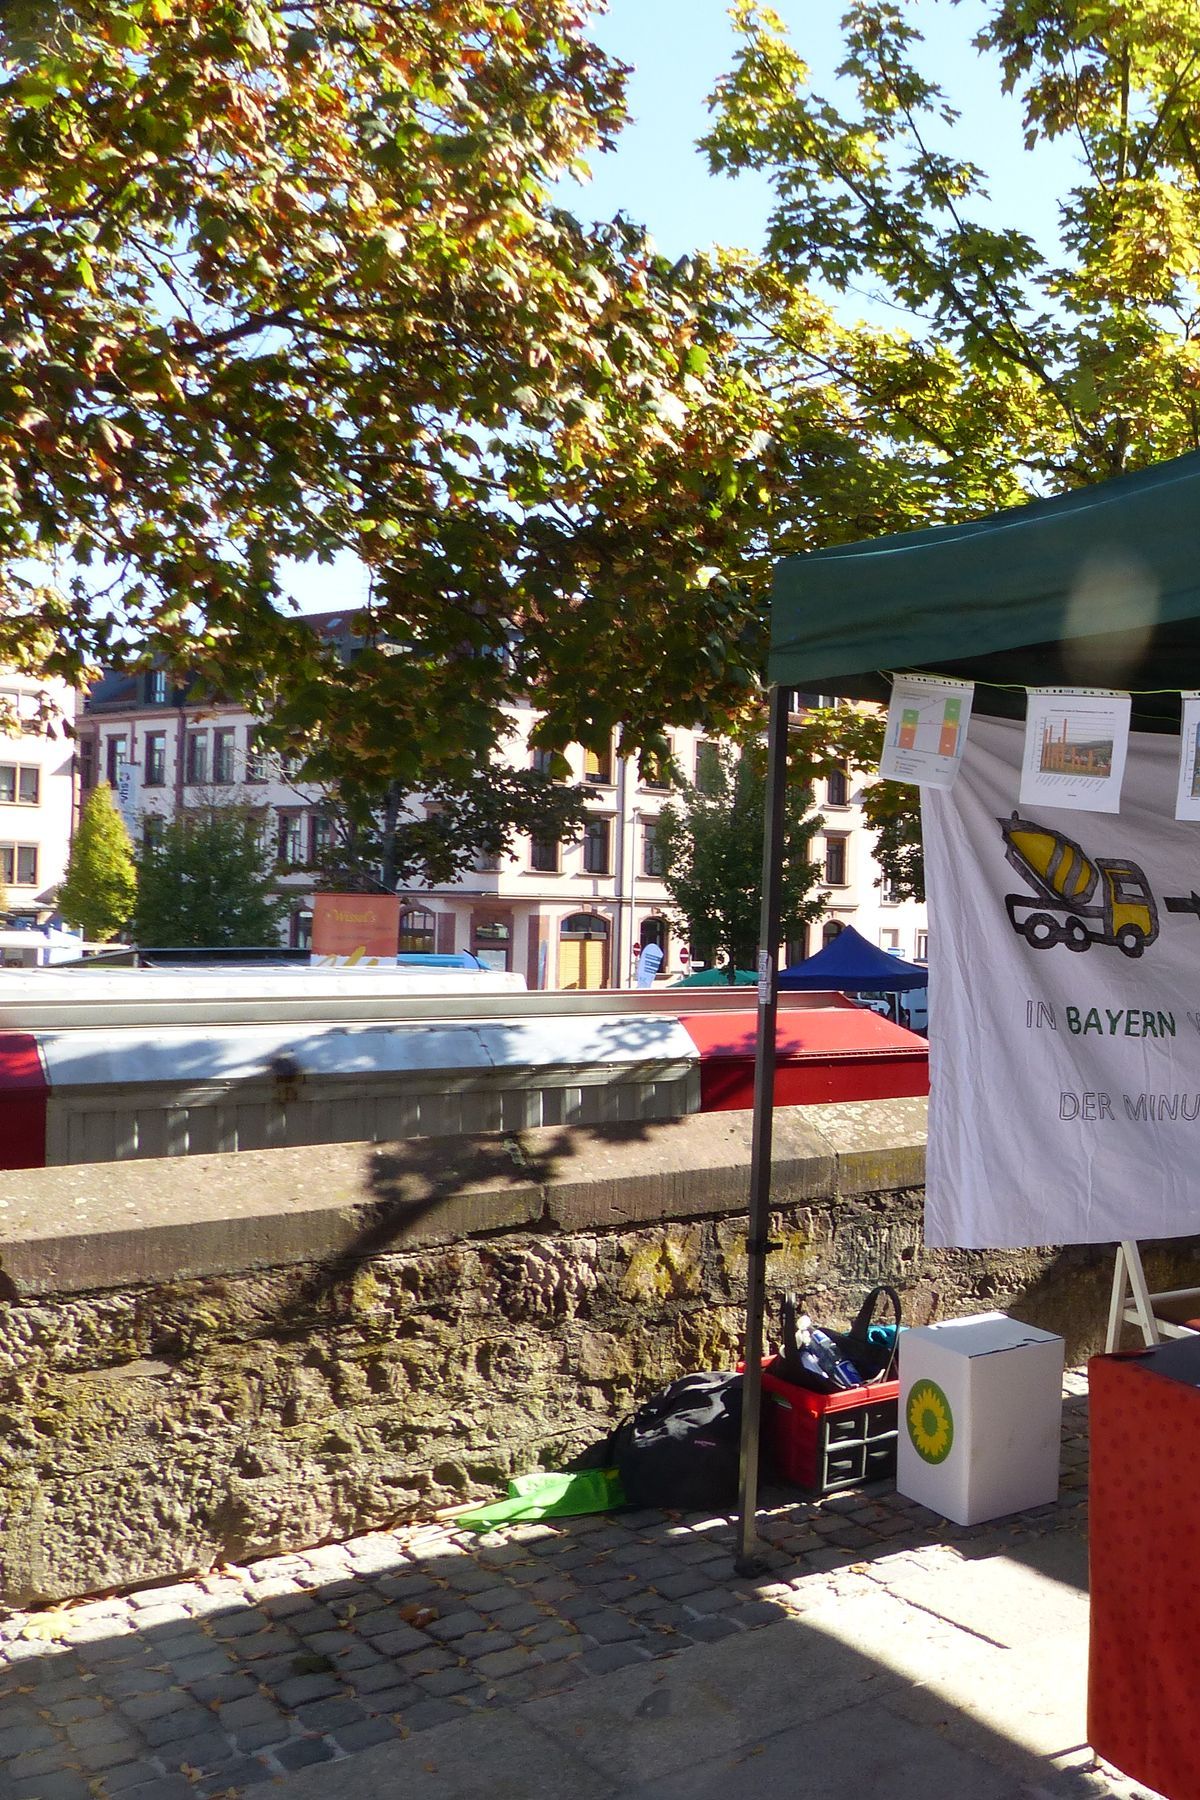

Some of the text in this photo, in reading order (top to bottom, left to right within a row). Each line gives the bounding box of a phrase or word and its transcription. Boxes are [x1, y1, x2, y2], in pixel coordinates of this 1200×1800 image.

[1026, 1000, 1057, 1030] IN
[1066, 1006, 1176, 1038] BAYERN
[1058, 1092, 1115, 1121] DER
